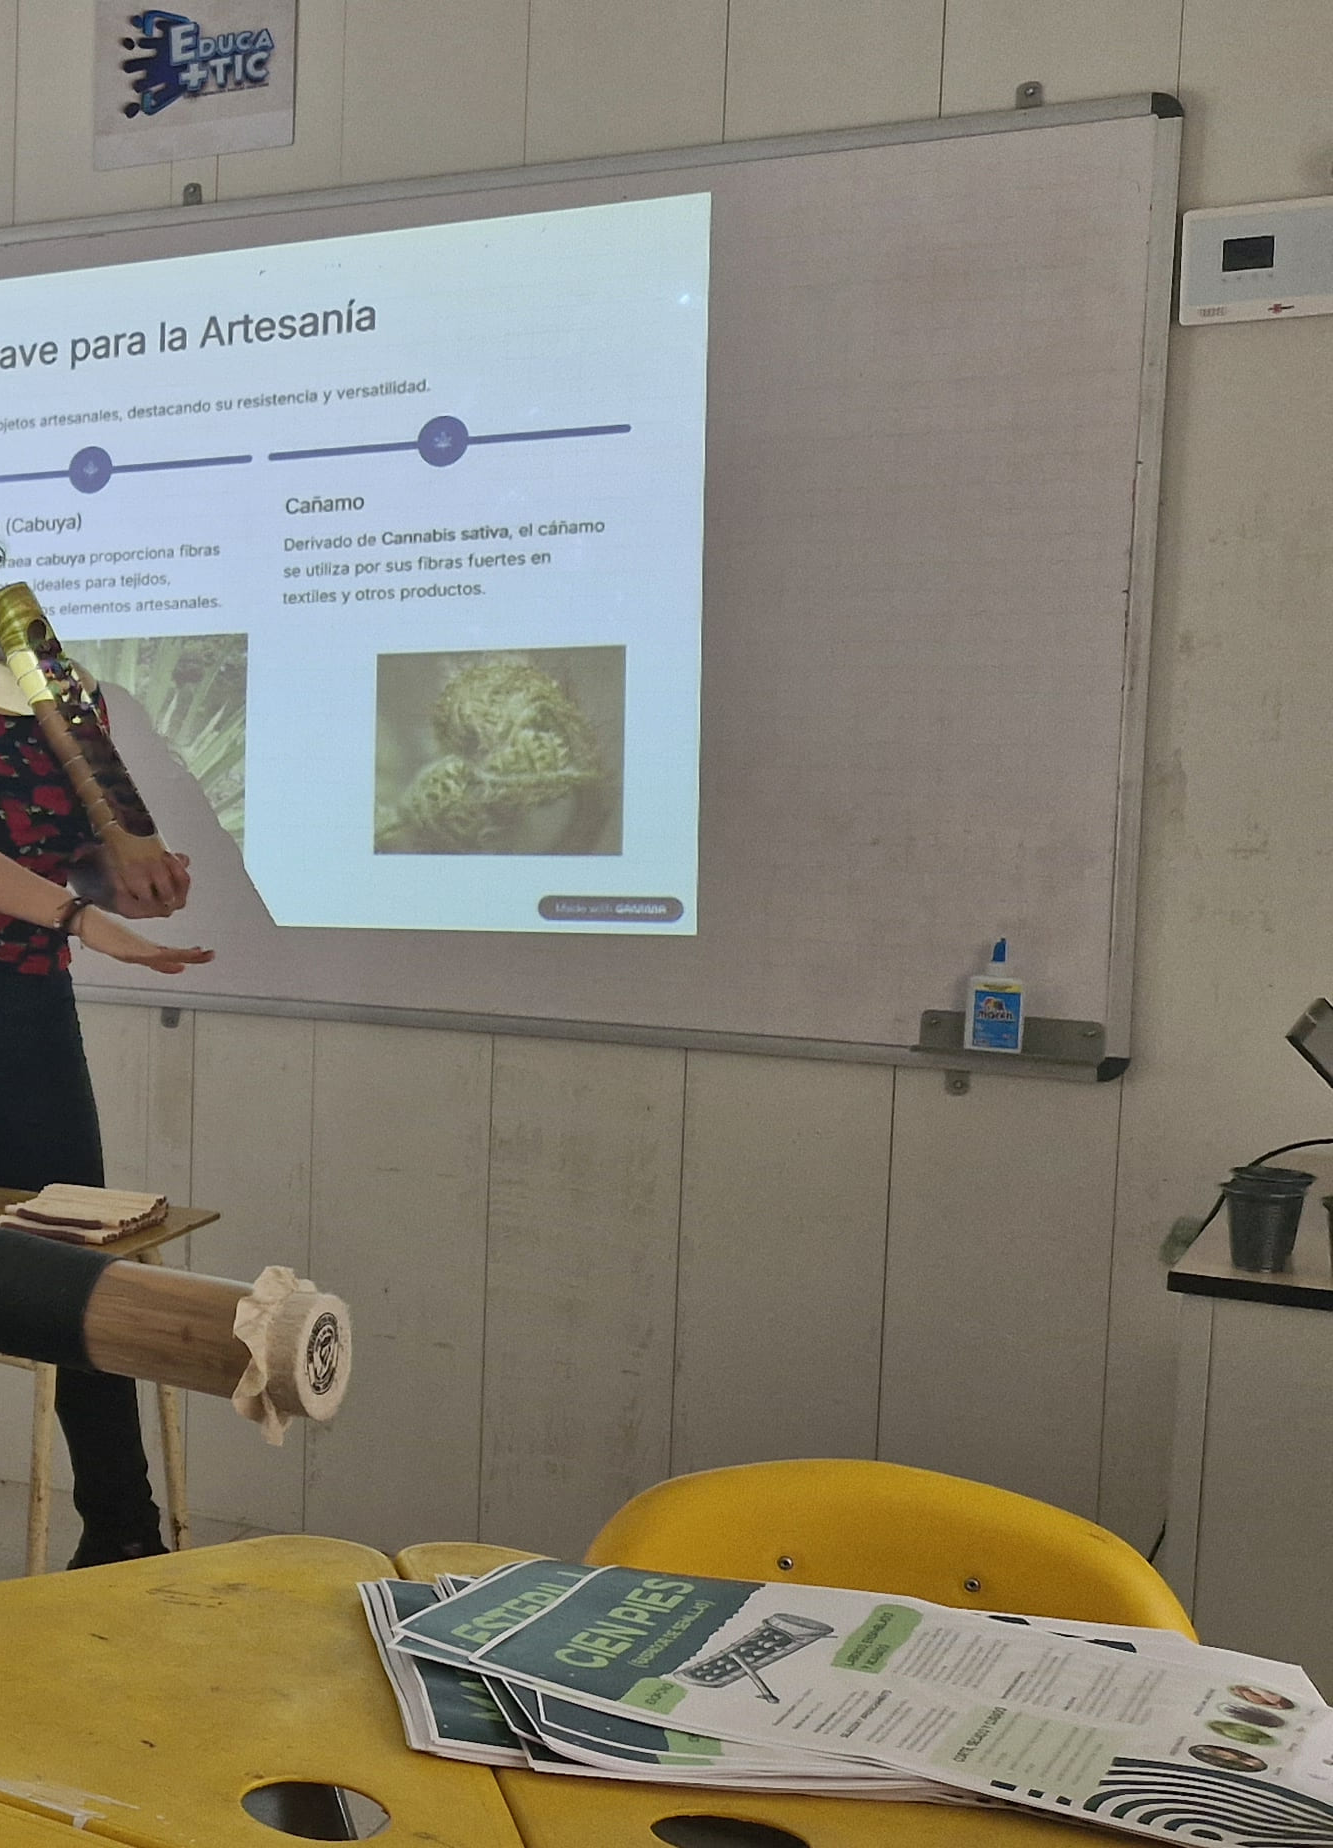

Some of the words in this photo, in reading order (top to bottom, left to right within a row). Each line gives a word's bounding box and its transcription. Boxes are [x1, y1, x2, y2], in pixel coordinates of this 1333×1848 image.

[170, 22, 275, 66] EDUCA
[70, 330, 146, 370] para
[159, 321, 188, 354] la
[199, 298, 377, 349] Artesanía
[39, 407, 123, 430] artesanales,
[127, 399, 211, 420] destacando
[216, 397, 233, 412] su
[237, 388, 319, 410] resistencia
[323, 389, 334, 405] y
[337, 379, 432, 400] versatilidad.
[285, 495, 365, 515] Cañamo
[5, 513, 83, 537] (Cabuya)
[284, 534, 353, 553] Derivado
[358, 533, 377, 547] de
[382, 526, 456, 546] Cannabis
[460, 523, 513, 542] sativa,
[519, 521, 533, 537] el
[35, 551, 85, 568] cabuya
[89, 546, 175, 565] proporciona
[179, 544, 221, 558] fibras
[284, 565, 302, 579] se
[306, 560, 350, 578] utiliza
[355, 561, 380, 577] por
[386, 558, 413, 572] sus
[418, 554, 463, 571] fibras
[468, 550, 526, 569] fuertes
[531, 551, 552, 565] en
[33, 577, 81, 592] ideales
[85, 577, 116, 591] para
[120, 572, 171, 589] tejidos,
[283, 587, 337, 605] textiles
[342, 590, 351, 605] y
[355, 584, 395, 601] otros
[400, 581, 486, 602] productos.
[59, 600, 131, 616] elementos
[135, 595, 222, 612] artesanales.
[554, 1620, 651, 1670] CIEN
[606, 1578, 695, 1626] PIES
